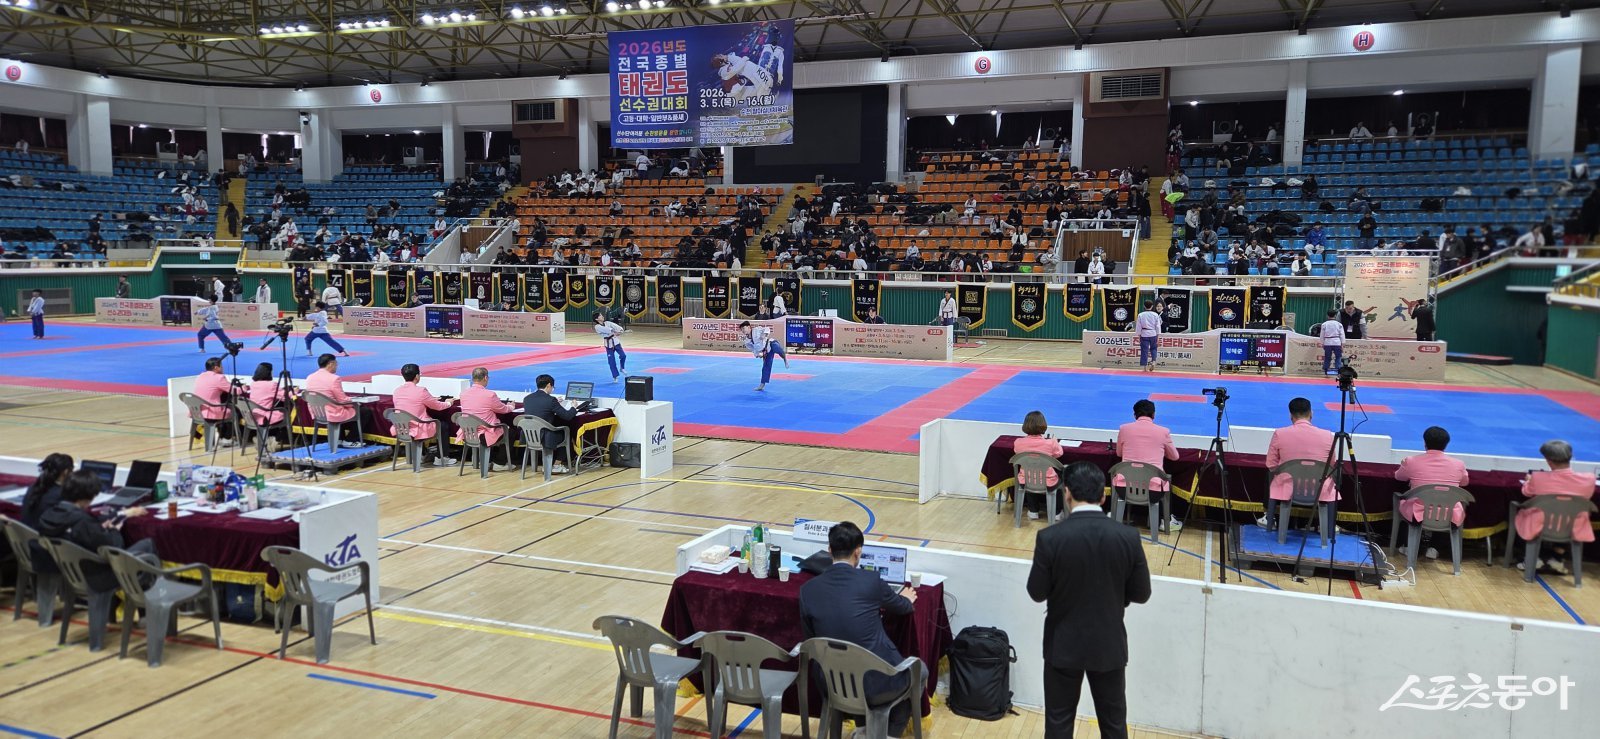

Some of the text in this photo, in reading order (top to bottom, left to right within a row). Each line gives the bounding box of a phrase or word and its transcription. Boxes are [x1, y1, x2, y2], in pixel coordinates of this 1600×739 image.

[1359, 33, 1369, 46] H
[618, 39, 687, 56] 2026년도
[618, 53, 687, 72] 전국종별
[979, 59, 987, 70] G
[618, 69, 688, 97] 태권도
[700, 88, 727, 98] 2026.
[619, 96, 688, 112] 선수권대회
[700, 98, 709, 108] 3.
[712, 97, 736, 108] 5.(목)
[692, 323, 719, 331] 2026년도
[701, 332, 739, 342] 선수권대회
[1095, 337, 1130, 346] 2026년도
[651, 424, 667, 446] KTA
[324, 533, 362, 567] KTA
